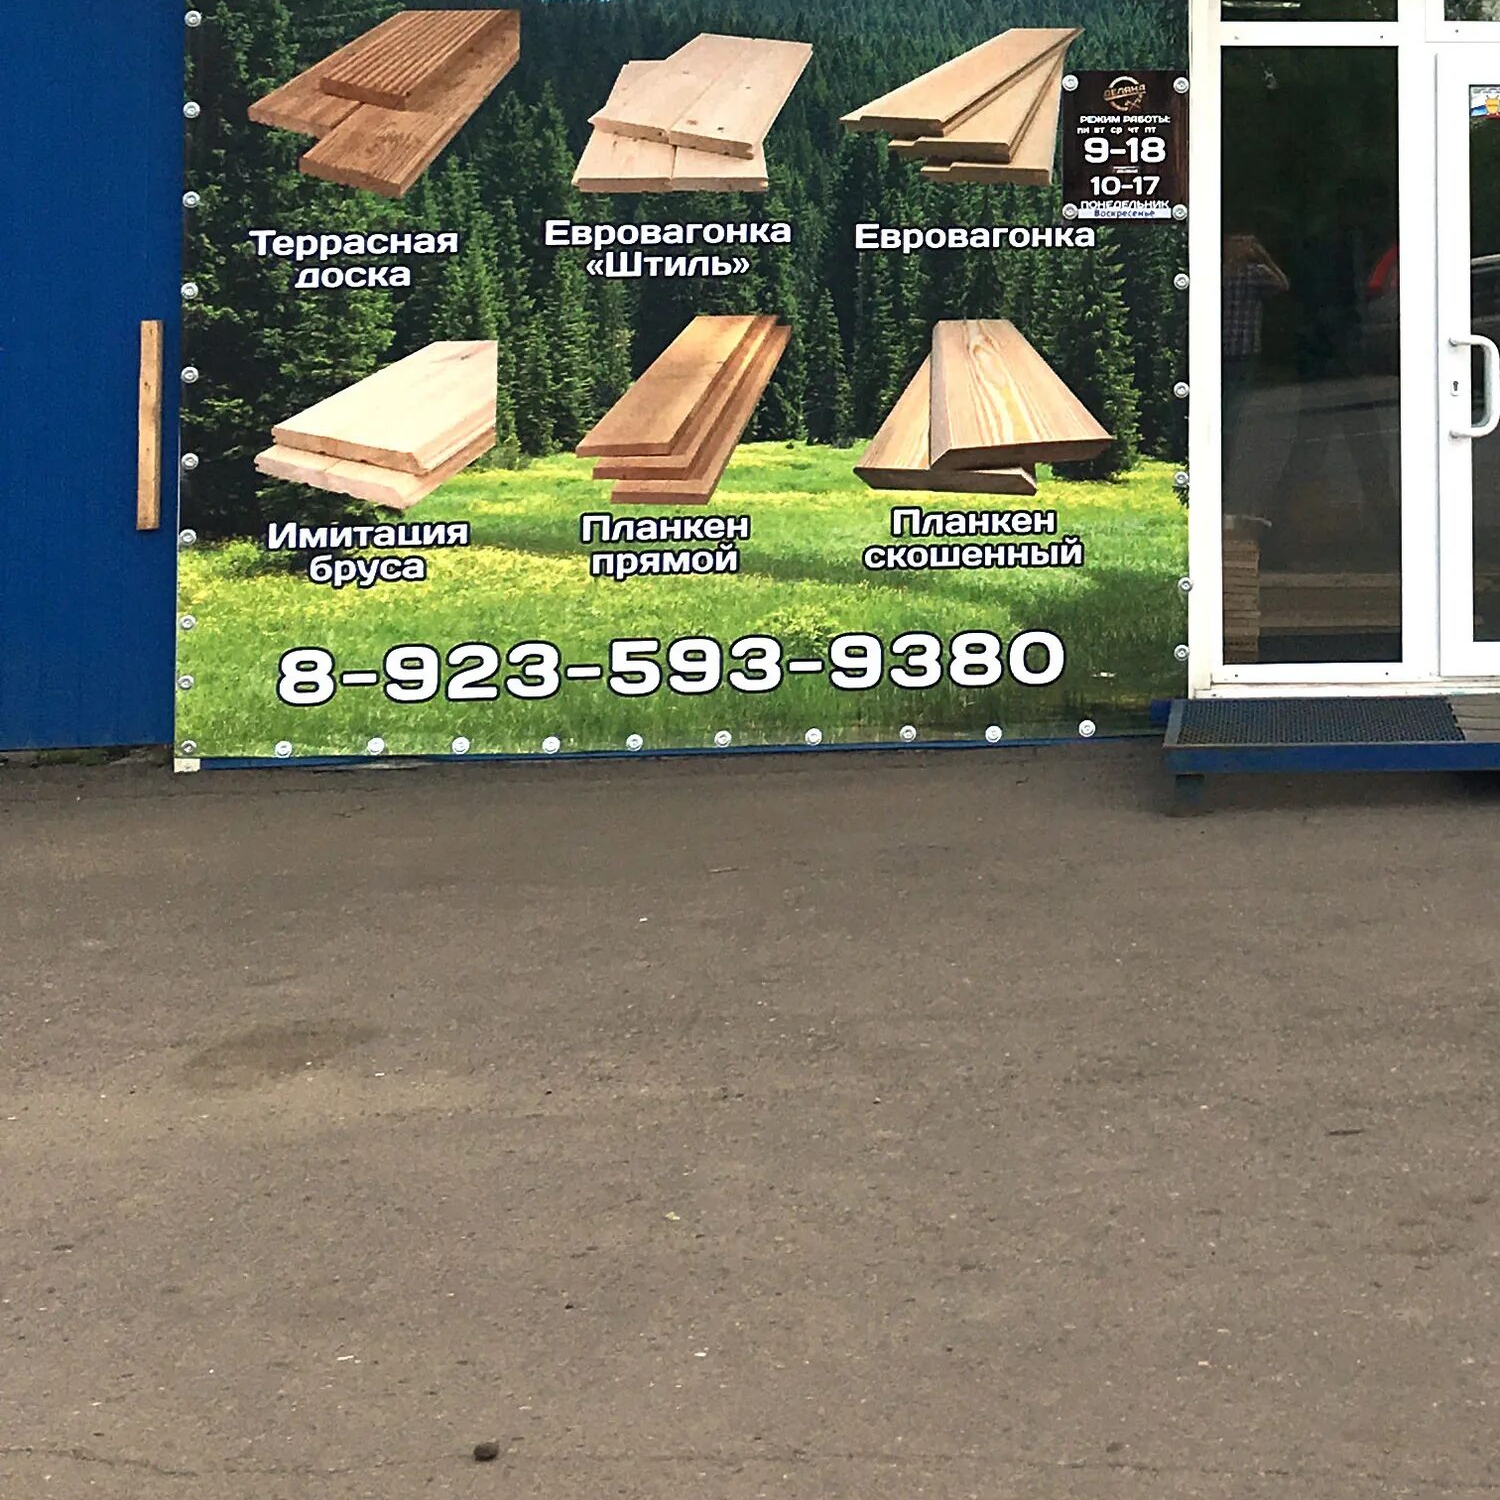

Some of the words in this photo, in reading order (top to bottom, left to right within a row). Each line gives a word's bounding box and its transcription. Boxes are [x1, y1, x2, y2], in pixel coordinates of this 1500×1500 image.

[1084, 136, 1166, 163] 9-18
[1090, 175, 1161, 196] 10-17
[1080, 200, 1170, 209] ПОНЕДЕЛЬНИК
[248, 229, 459, 258] Террасная
[544, 218, 792, 248] Евровагонка
[854, 221, 1096, 249] Евровагонка
[294, 264, 412, 290] доска
[586, 251, 751, 279] «Штиль»
[267, 518, 469, 550] Имитация
[581, 514, 749, 544] Планкен
[892, 508, 1056, 539] Планкен
[592, 542, 738, 578] прямой
[863, 534, 1083, 569] скошенный
[308, 552, 426, 587] бруса
[278, 630, 1065, 705] 8-923-593-9380
